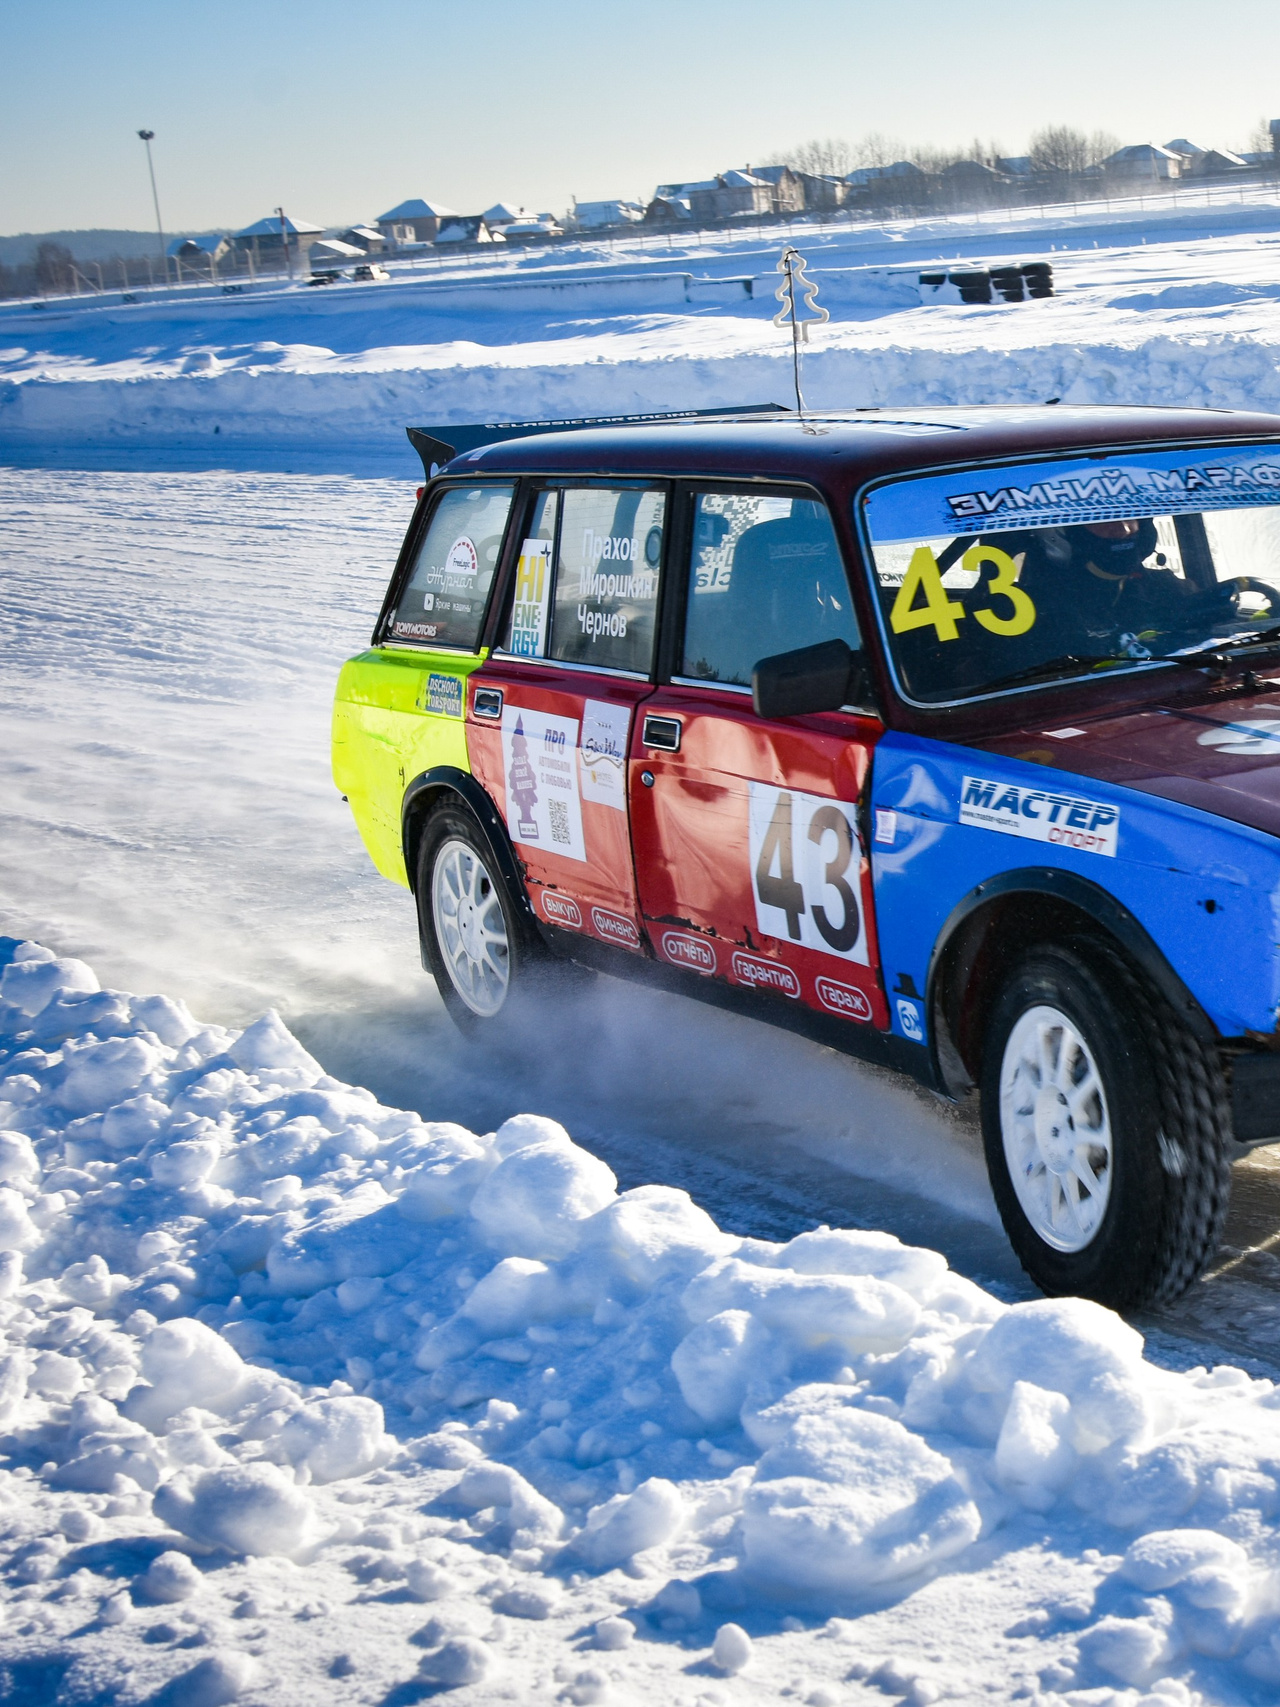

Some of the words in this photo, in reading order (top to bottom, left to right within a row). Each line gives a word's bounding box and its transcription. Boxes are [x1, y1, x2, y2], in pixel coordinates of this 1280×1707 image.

[498, 419, 584, 429] CLASSIC
[585, 416, 625, 425] CAR
[627, 411, 698, 421] RACING
[946, 469, 1138, 519] ЗИМНИЙ
[583, 528, 639, 566] Прахов
[516, 555, 546, 603] HI
[889, 545, 1036, 643] 43
[577, 604, 627, 643] Чернов
[512, 630, 539, 655] RGY
[545, 728, 566, 755] ПРО
[963, 779, 1118, 832] МАСТЕР
[1048, 827, 1108, 853] СПОРТ
[755, 790, 861, 953] 43
[546, 897, 578, 921] выкуп
[595, 911, 636, 940] финанс
[667, 940, 712, 966] отчёты
[737, 959, 795, 990] гарантия
[821, 984, 866, 1013] гараж
